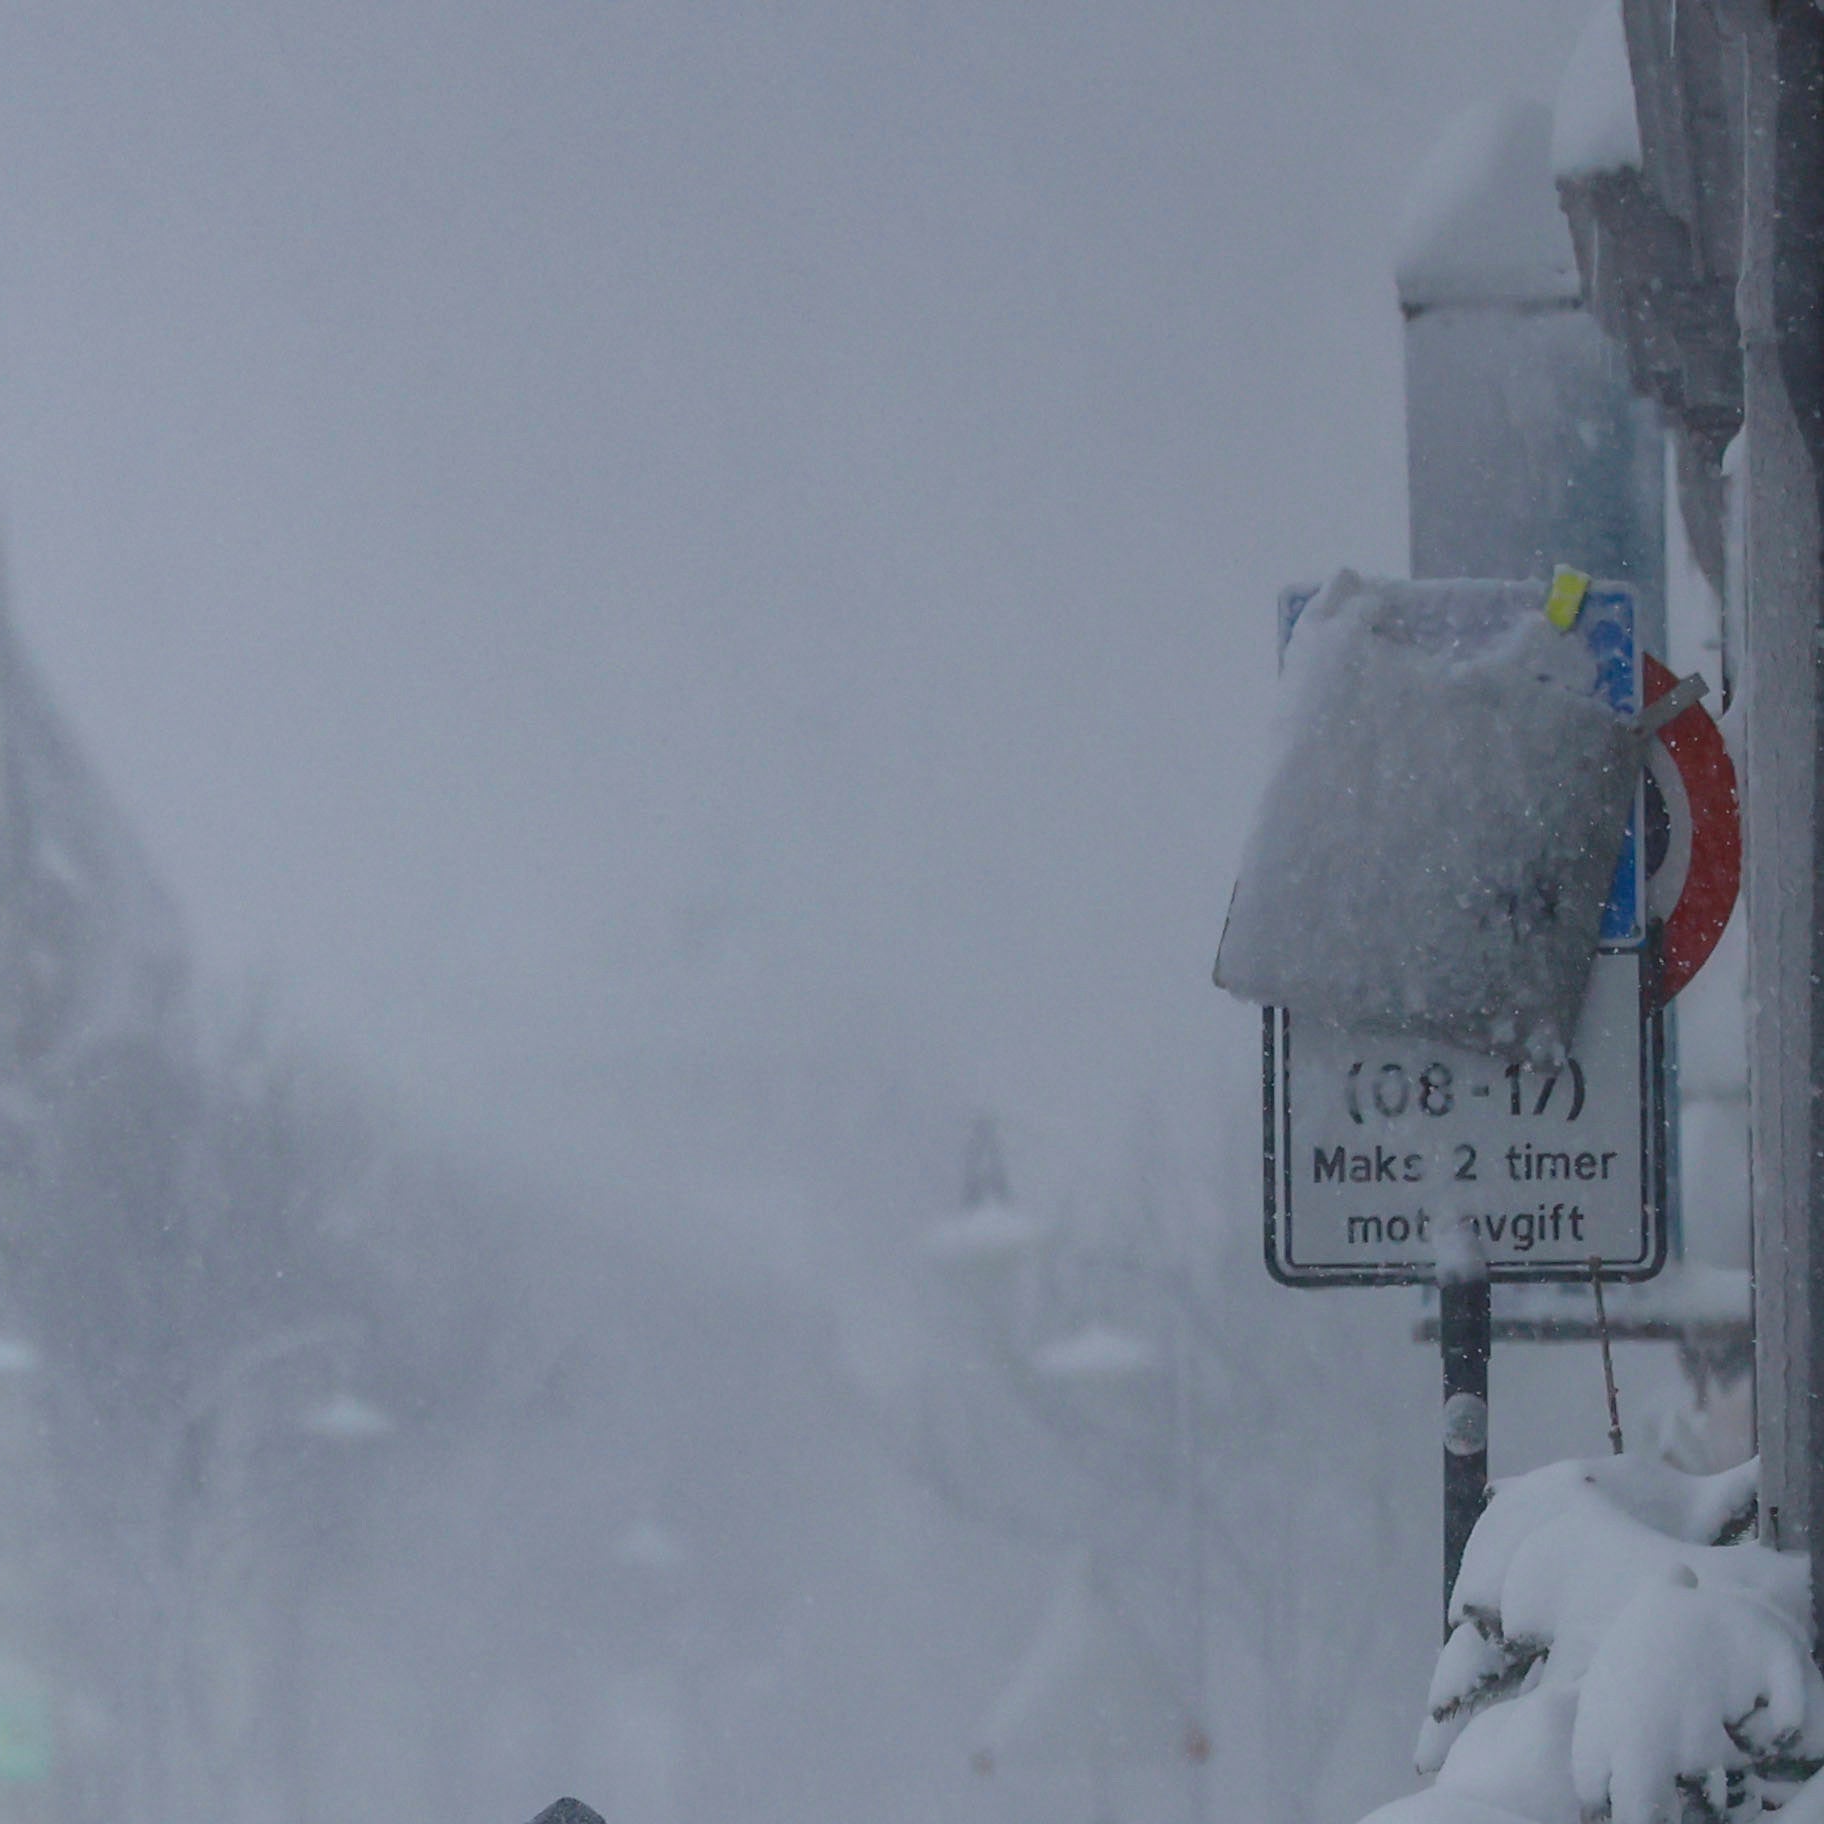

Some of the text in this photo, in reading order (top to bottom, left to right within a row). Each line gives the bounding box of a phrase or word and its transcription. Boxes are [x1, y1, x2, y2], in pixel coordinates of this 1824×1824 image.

[1312, 1142, 1618, 1184] Maks 2 timer
[1348, 1208, 1430, 1244] mot
